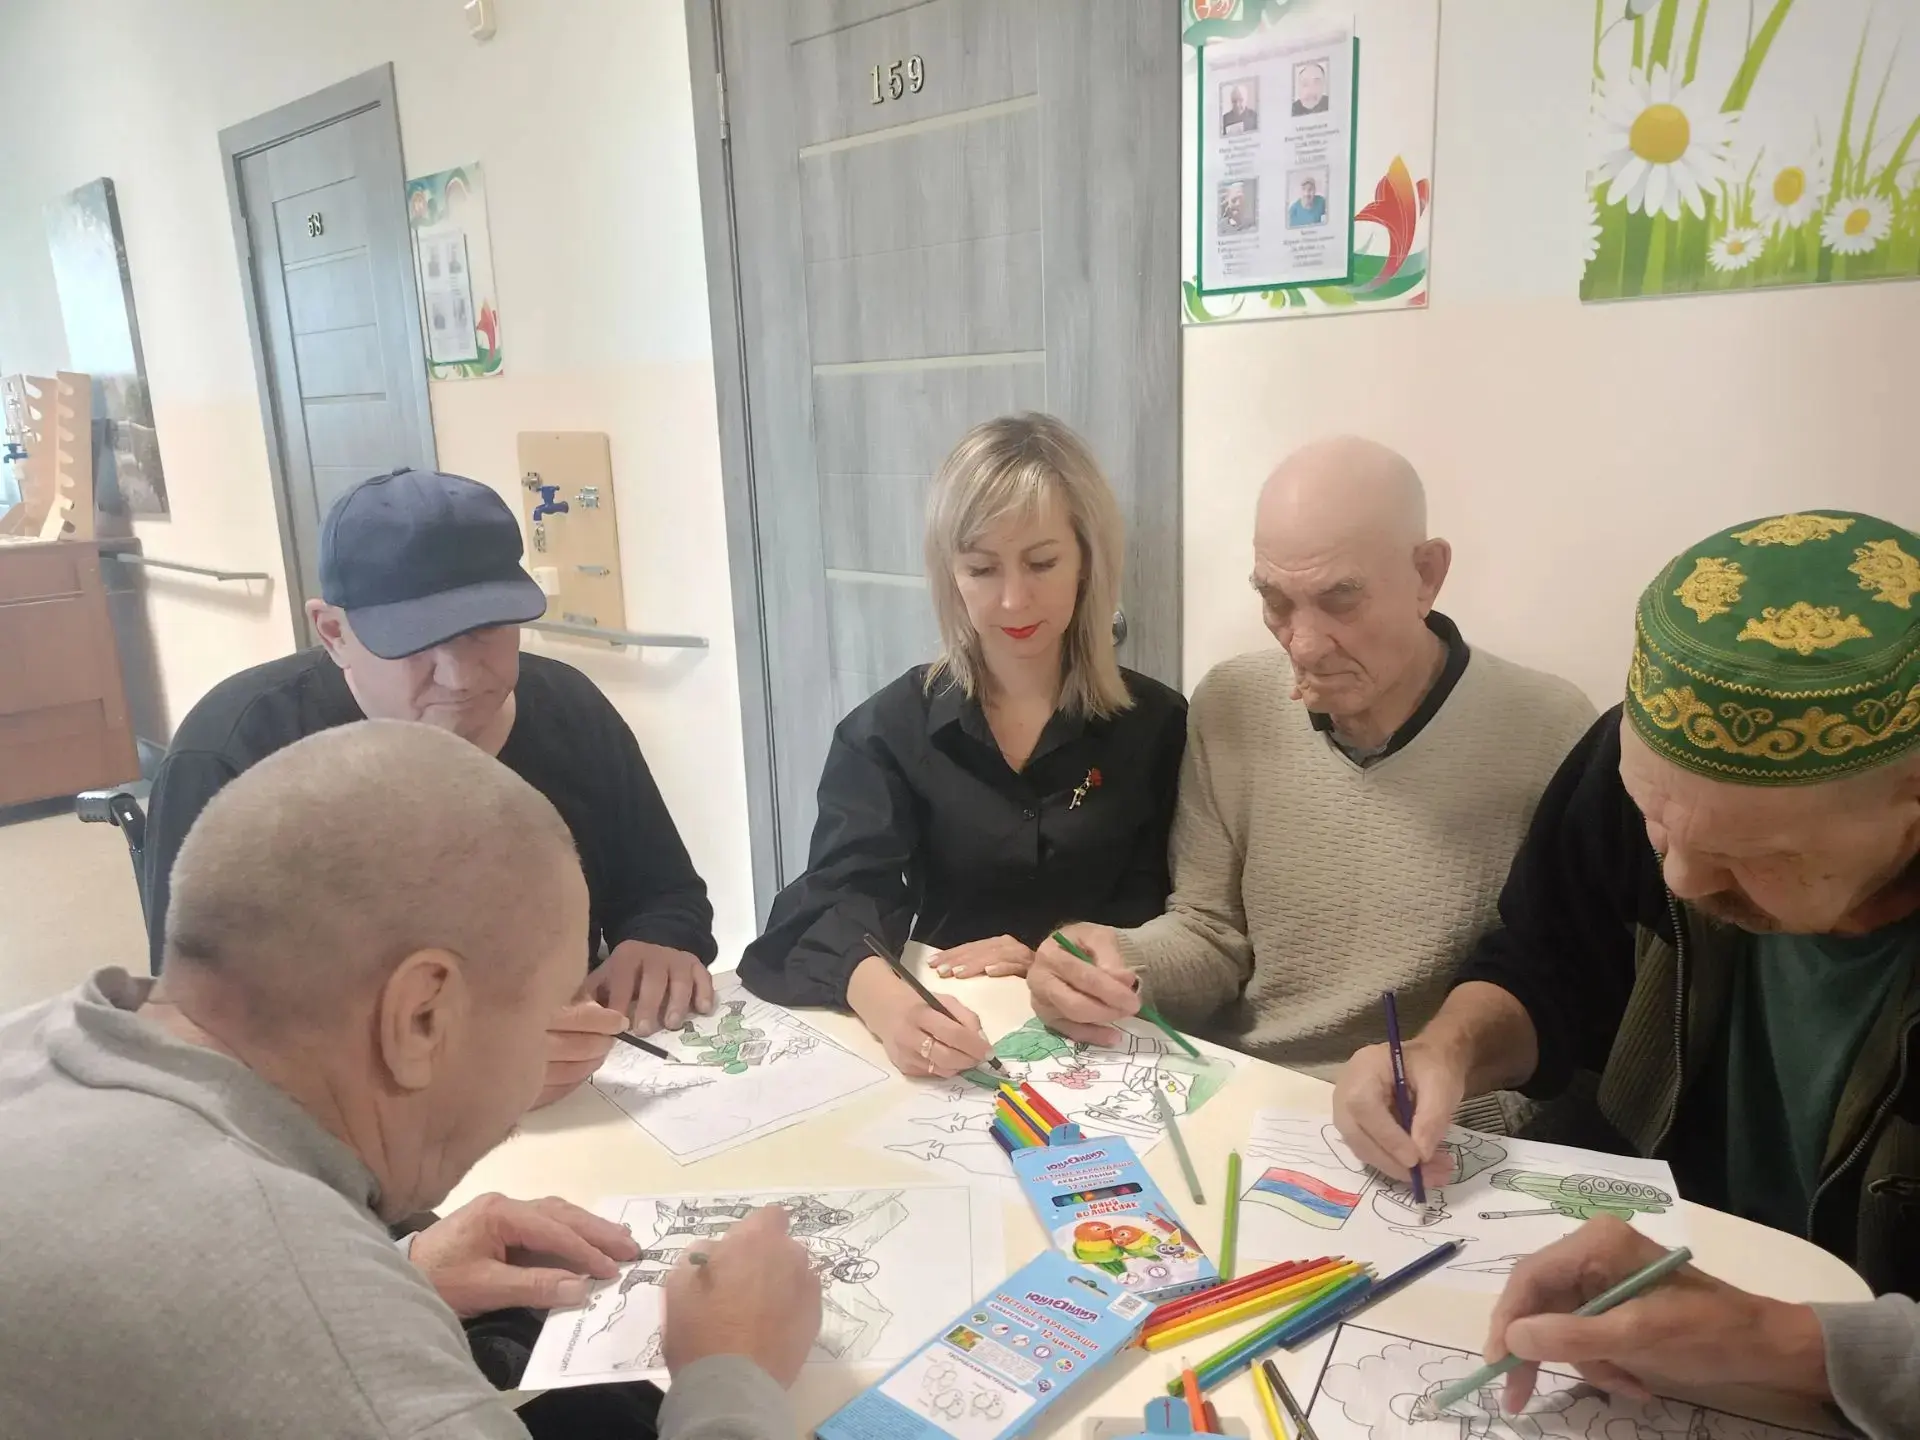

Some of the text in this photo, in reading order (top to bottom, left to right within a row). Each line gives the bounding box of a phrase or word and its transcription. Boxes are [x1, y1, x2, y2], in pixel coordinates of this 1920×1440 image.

[870, 54, 924, 104] 159
[1047, 1150, 1105, 1171] ЮНЛАНДИЯ
[996, 1293, 1037, 1320] ЦВЕТНЫЕ
[1037, 1314, 1099, 1351] КАРАНДАШИ
[1025, 1291, 1099, 1323] ЮНЛАНДИЯ
[1040, 1328, 1053, 1339] 12
